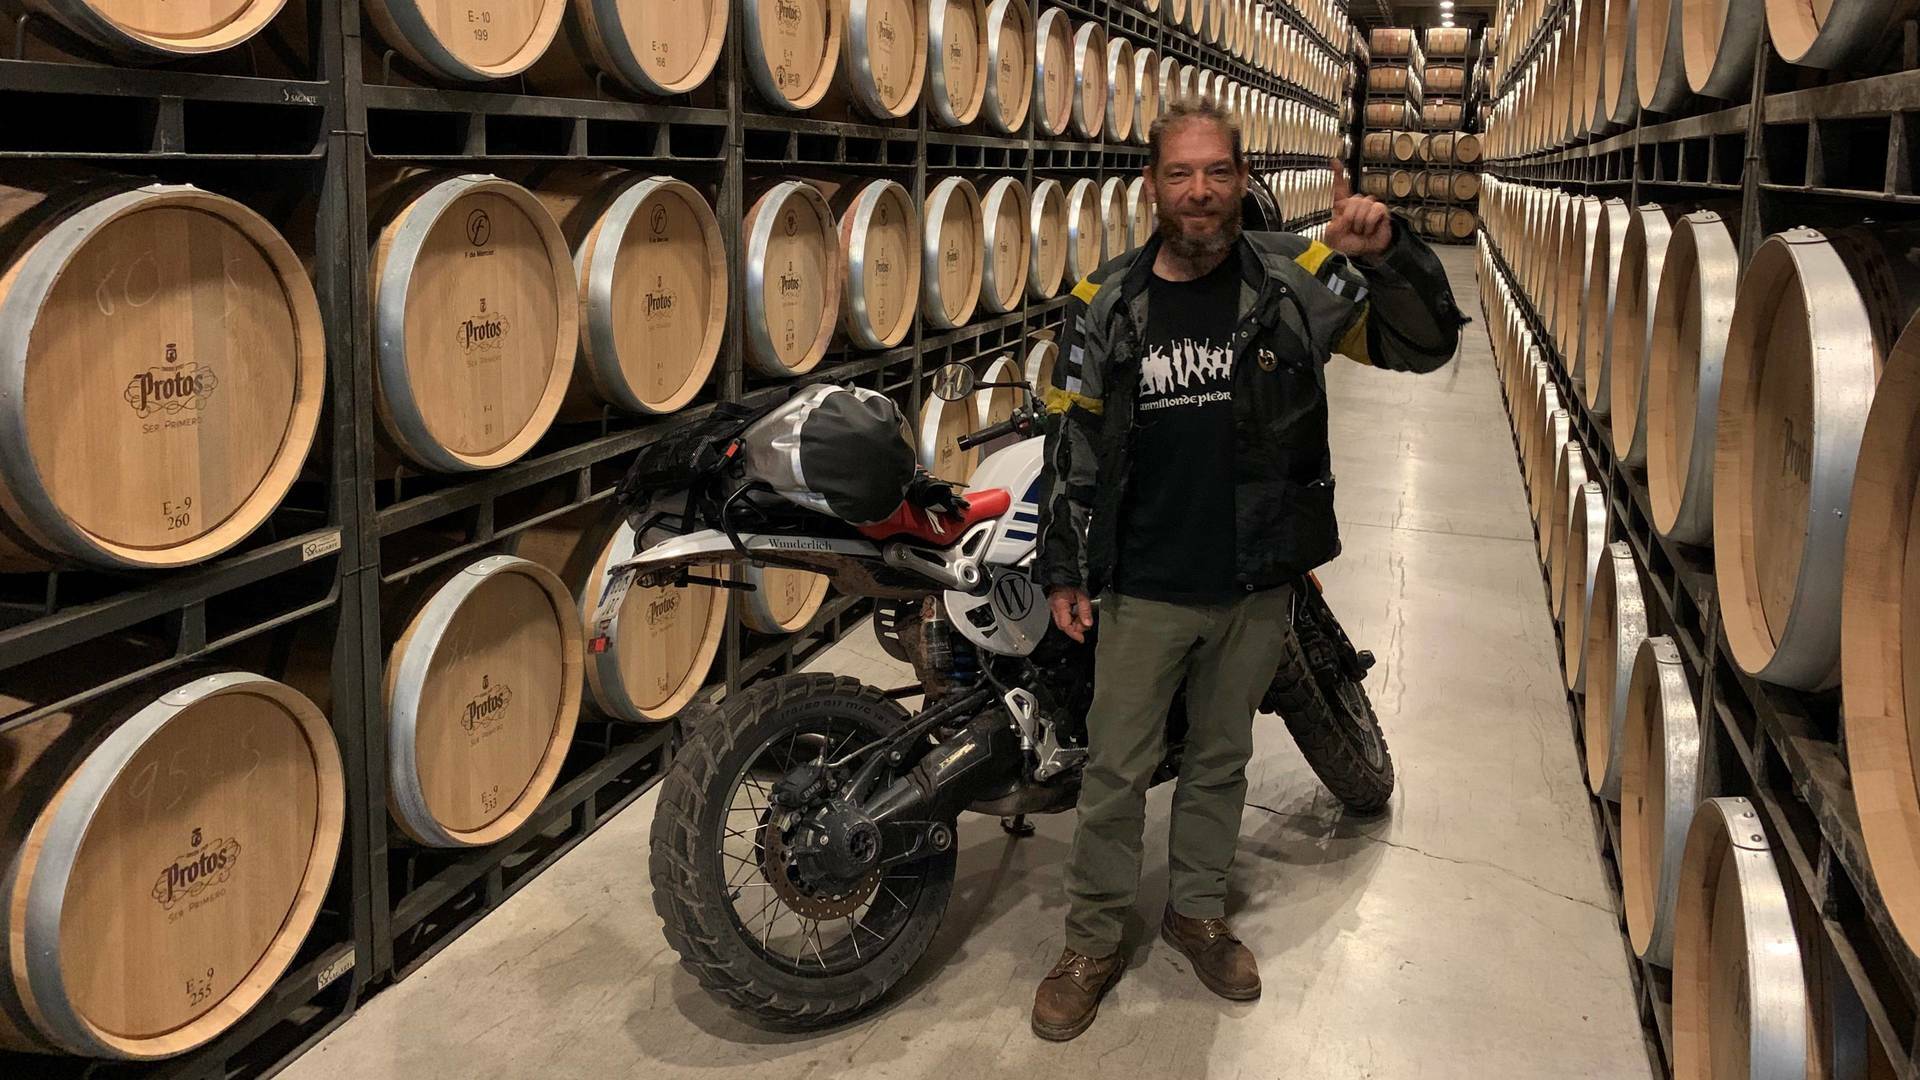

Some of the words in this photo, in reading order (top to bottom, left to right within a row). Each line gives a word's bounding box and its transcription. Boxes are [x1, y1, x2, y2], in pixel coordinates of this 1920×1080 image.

[473, 29, 489, 41] 199
[645, 293, 672, 316] Protos
[461, 319, 502, 350] Protos
[133, 371, 204, 412] Protos
[167, 512, 191, 531] 260
[768, 538, 832, 551] Wunderlich
[465, 692, 503, 731] Protos
[161, 847, 227, 902] Protos
[191, 983, 212, 1007] 255
